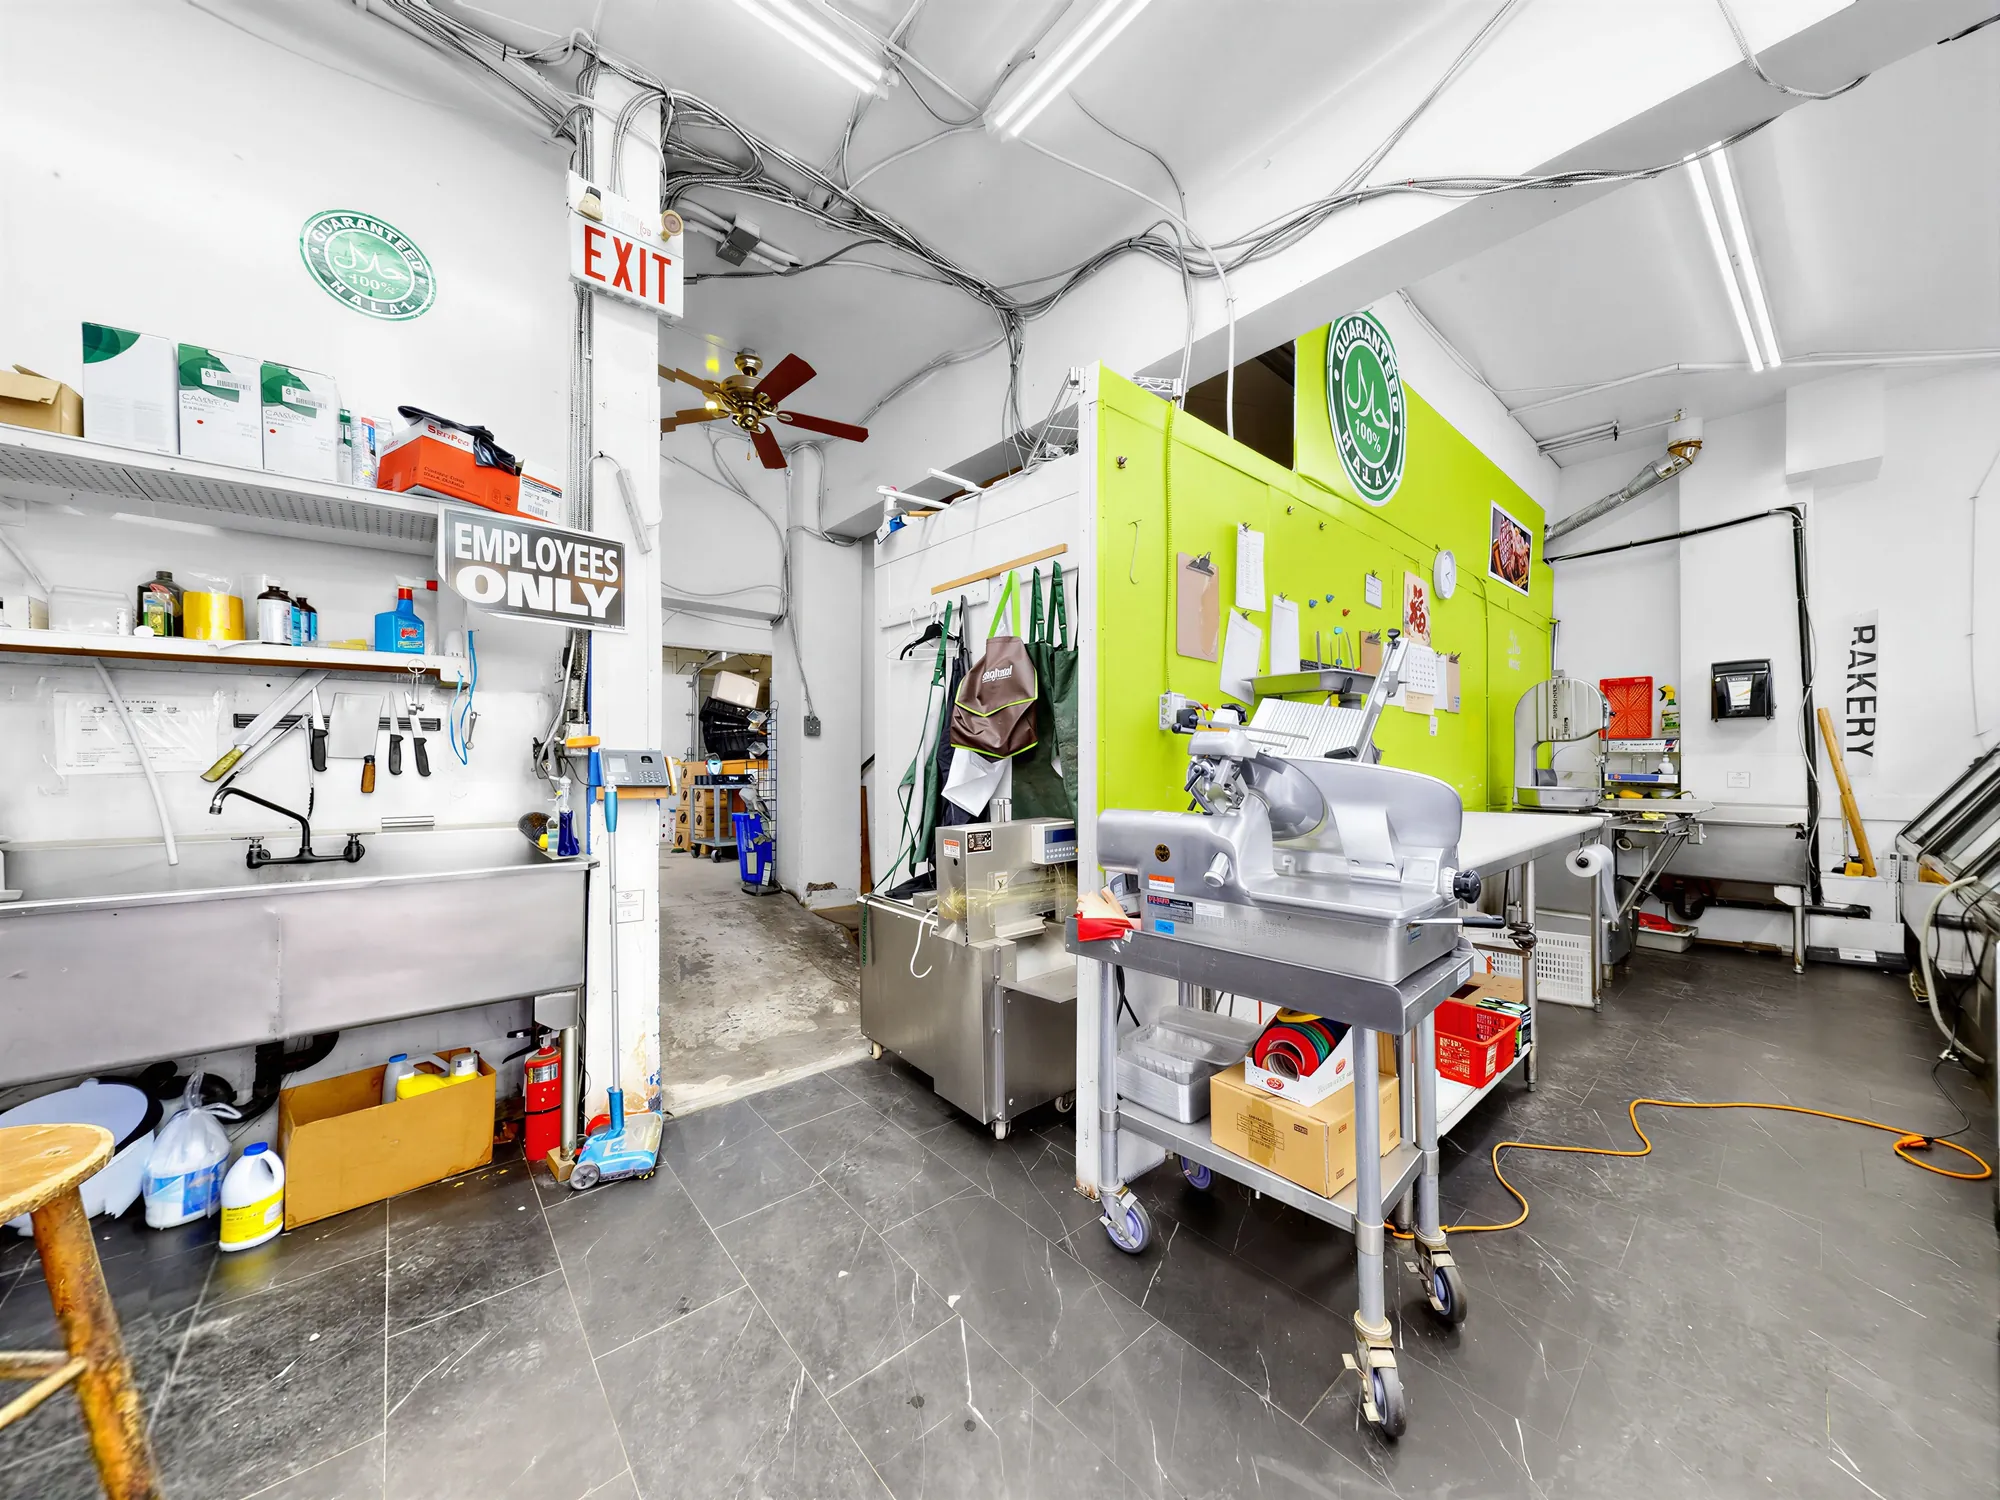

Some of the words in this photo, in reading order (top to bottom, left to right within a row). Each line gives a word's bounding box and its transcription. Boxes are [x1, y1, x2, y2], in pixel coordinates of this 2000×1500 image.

[312, 216, 425, 272] GUARANTEED
[585, 224, 672, 305] EXIT
[330, 279, 415, 315] HALAL
[1334, 319, 1399, 413] GUARANTEED
[1346, 358, 1391, 430] حلال
[1342, 430, 1391, 488] HALAL
[1354, 418, 1381, 453] 100%
[454, 521, 619, 583] EMPLOYEES
[455, 565, 619, 619] ONLY
